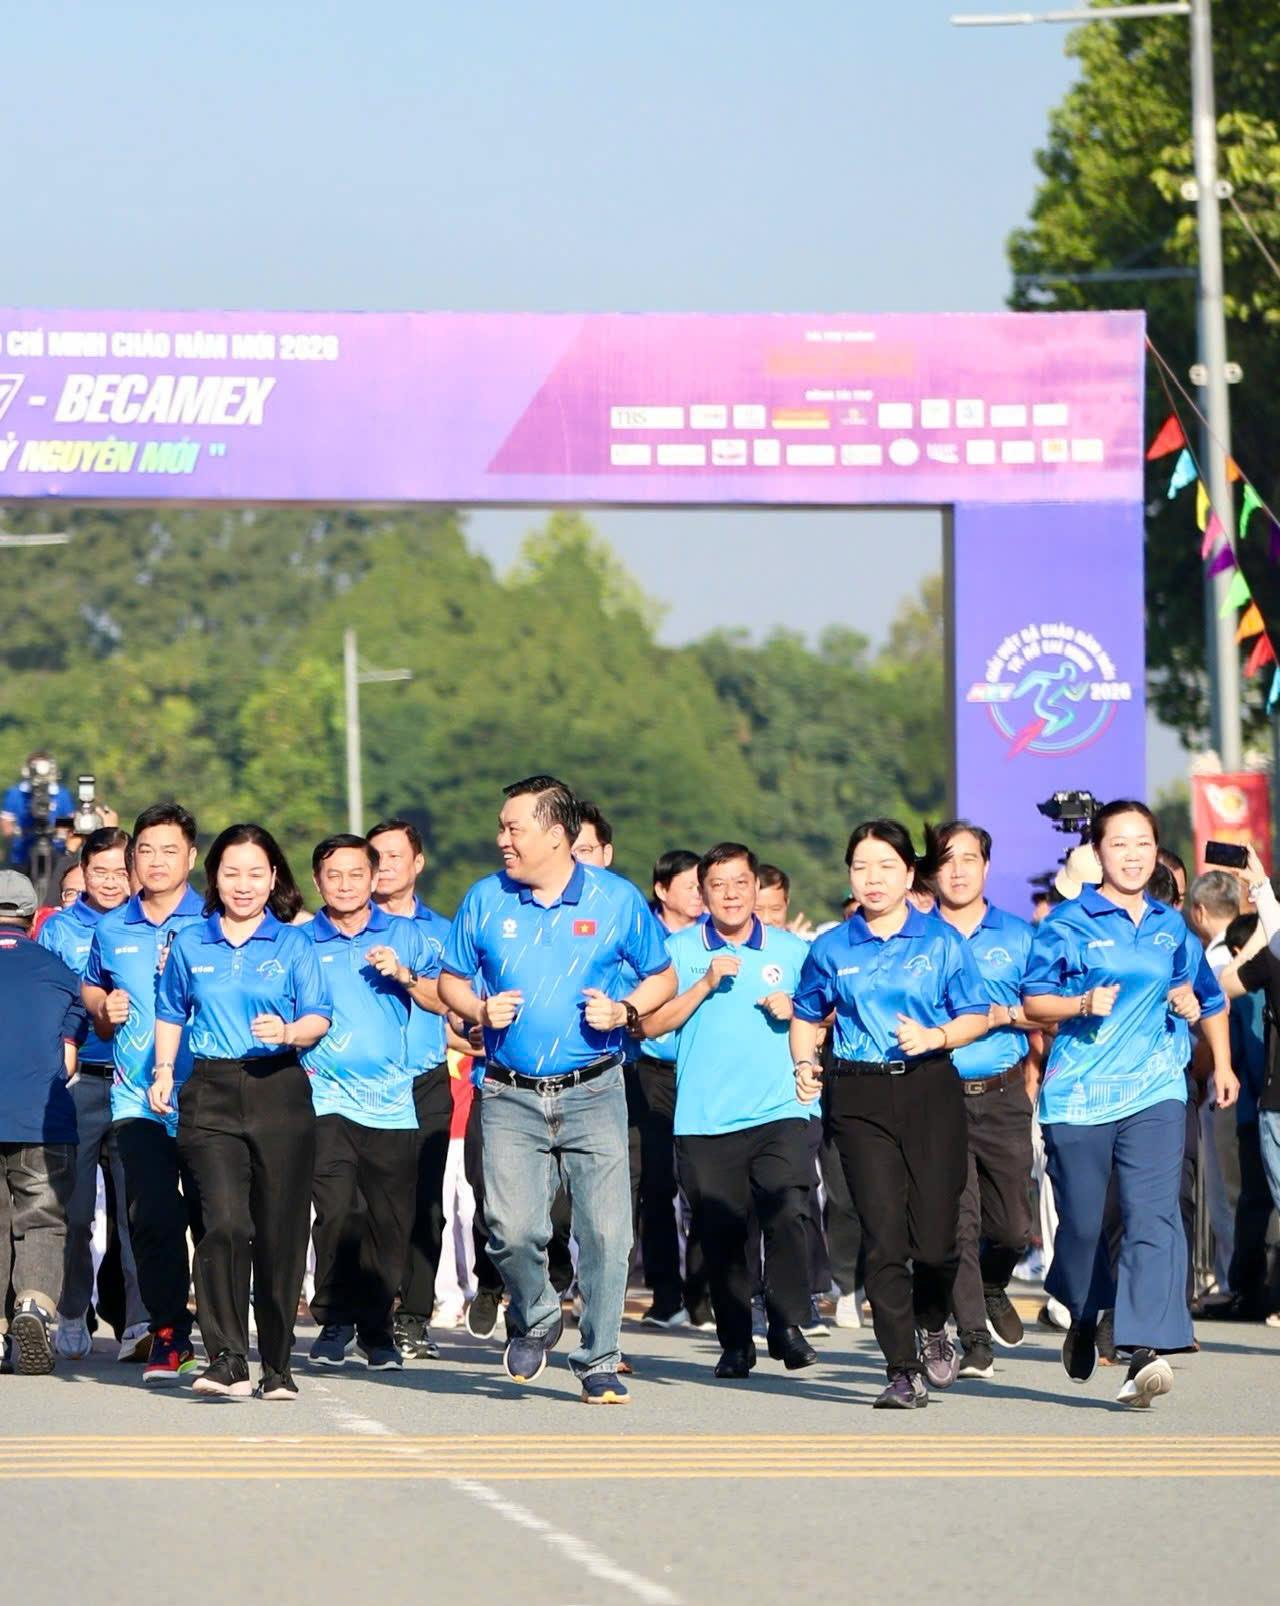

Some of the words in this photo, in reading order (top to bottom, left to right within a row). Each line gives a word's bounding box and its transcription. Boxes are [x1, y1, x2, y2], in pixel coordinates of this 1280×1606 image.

[55, 374, 276, 425] BECAMEX
[18, 435, 138, 473] NGUYÊN
[138, 435, 201, 474] MỚI
